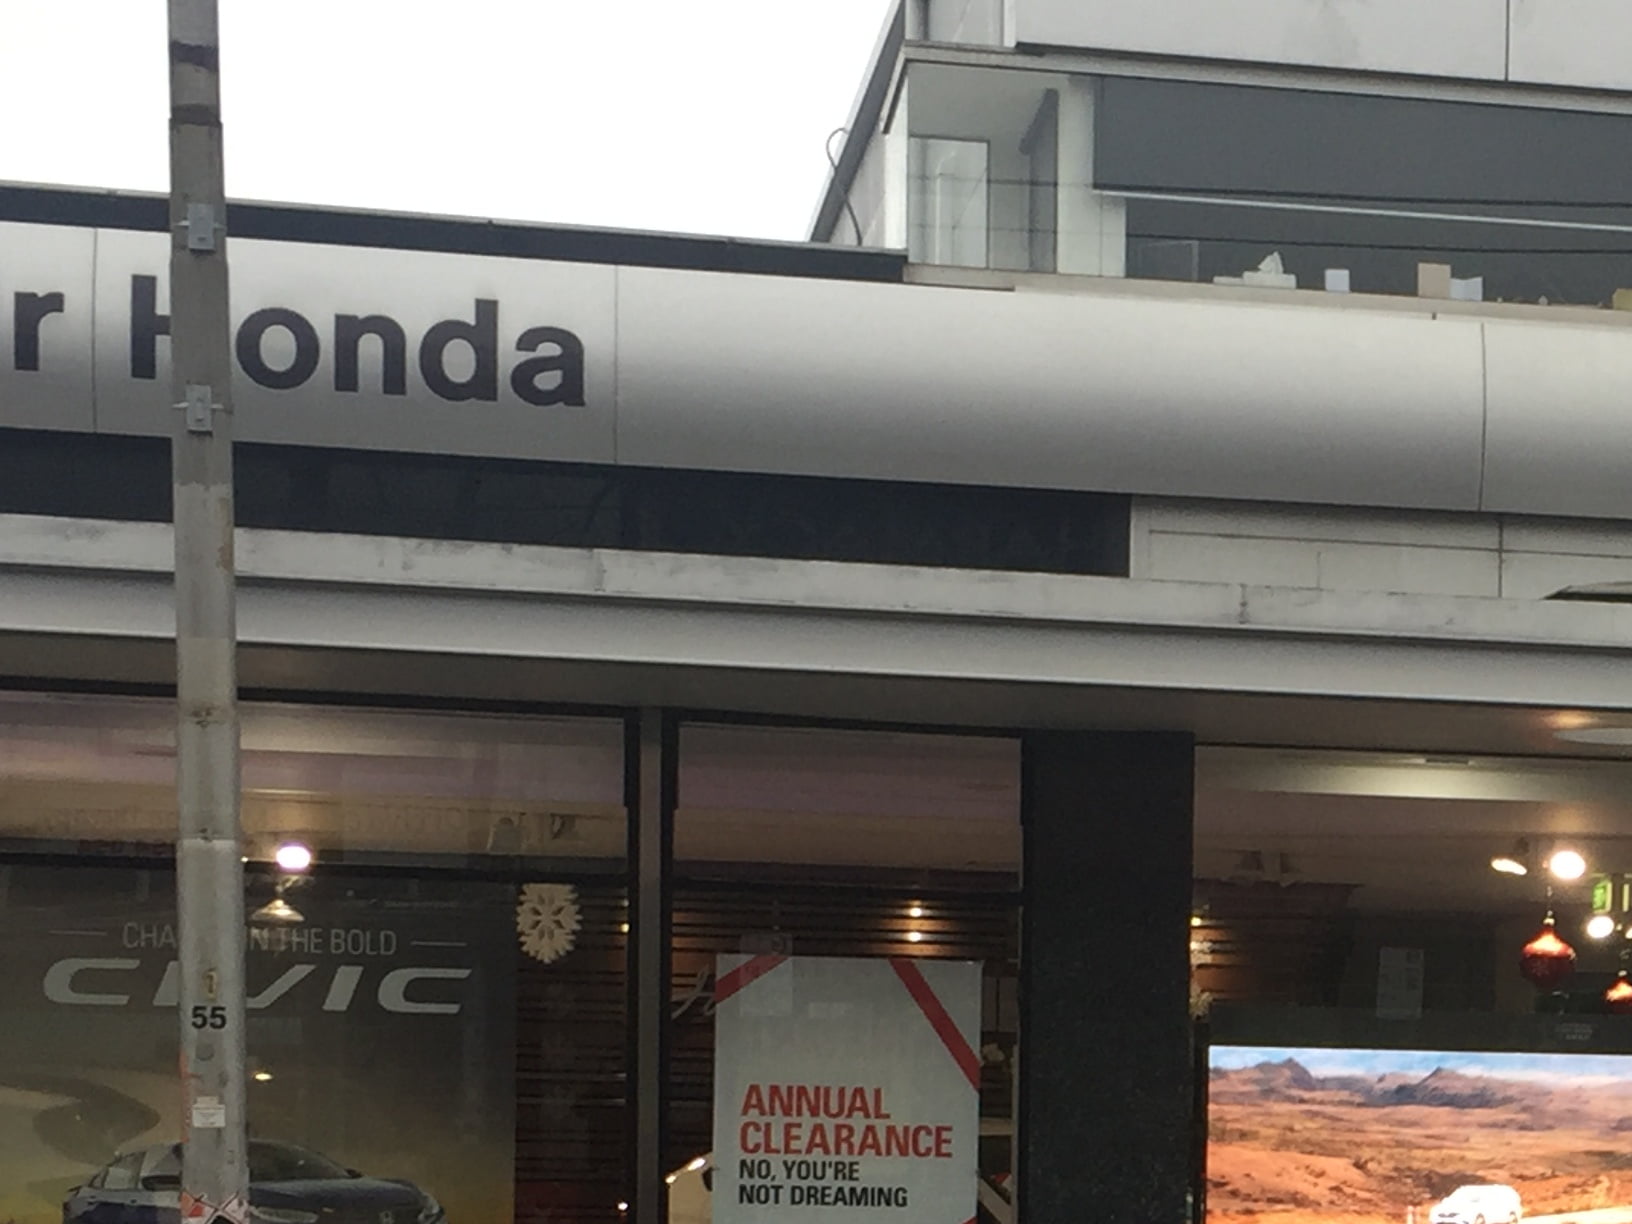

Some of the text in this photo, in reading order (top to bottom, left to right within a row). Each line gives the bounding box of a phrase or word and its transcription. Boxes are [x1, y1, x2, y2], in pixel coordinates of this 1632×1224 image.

[274, 926, 323, 953] THE
[330, 927, 397, 956] BOLD
[191, 1005, 227, 1029] 55
[740, 1083, 891, 1119] ANNUAL
[739, 1120, 954, 1158] CLEARANCE
[738, 1159, 860, 1182] NO, YOU'RE
[738, 1184, 908, 1208] NOT DREAMING
